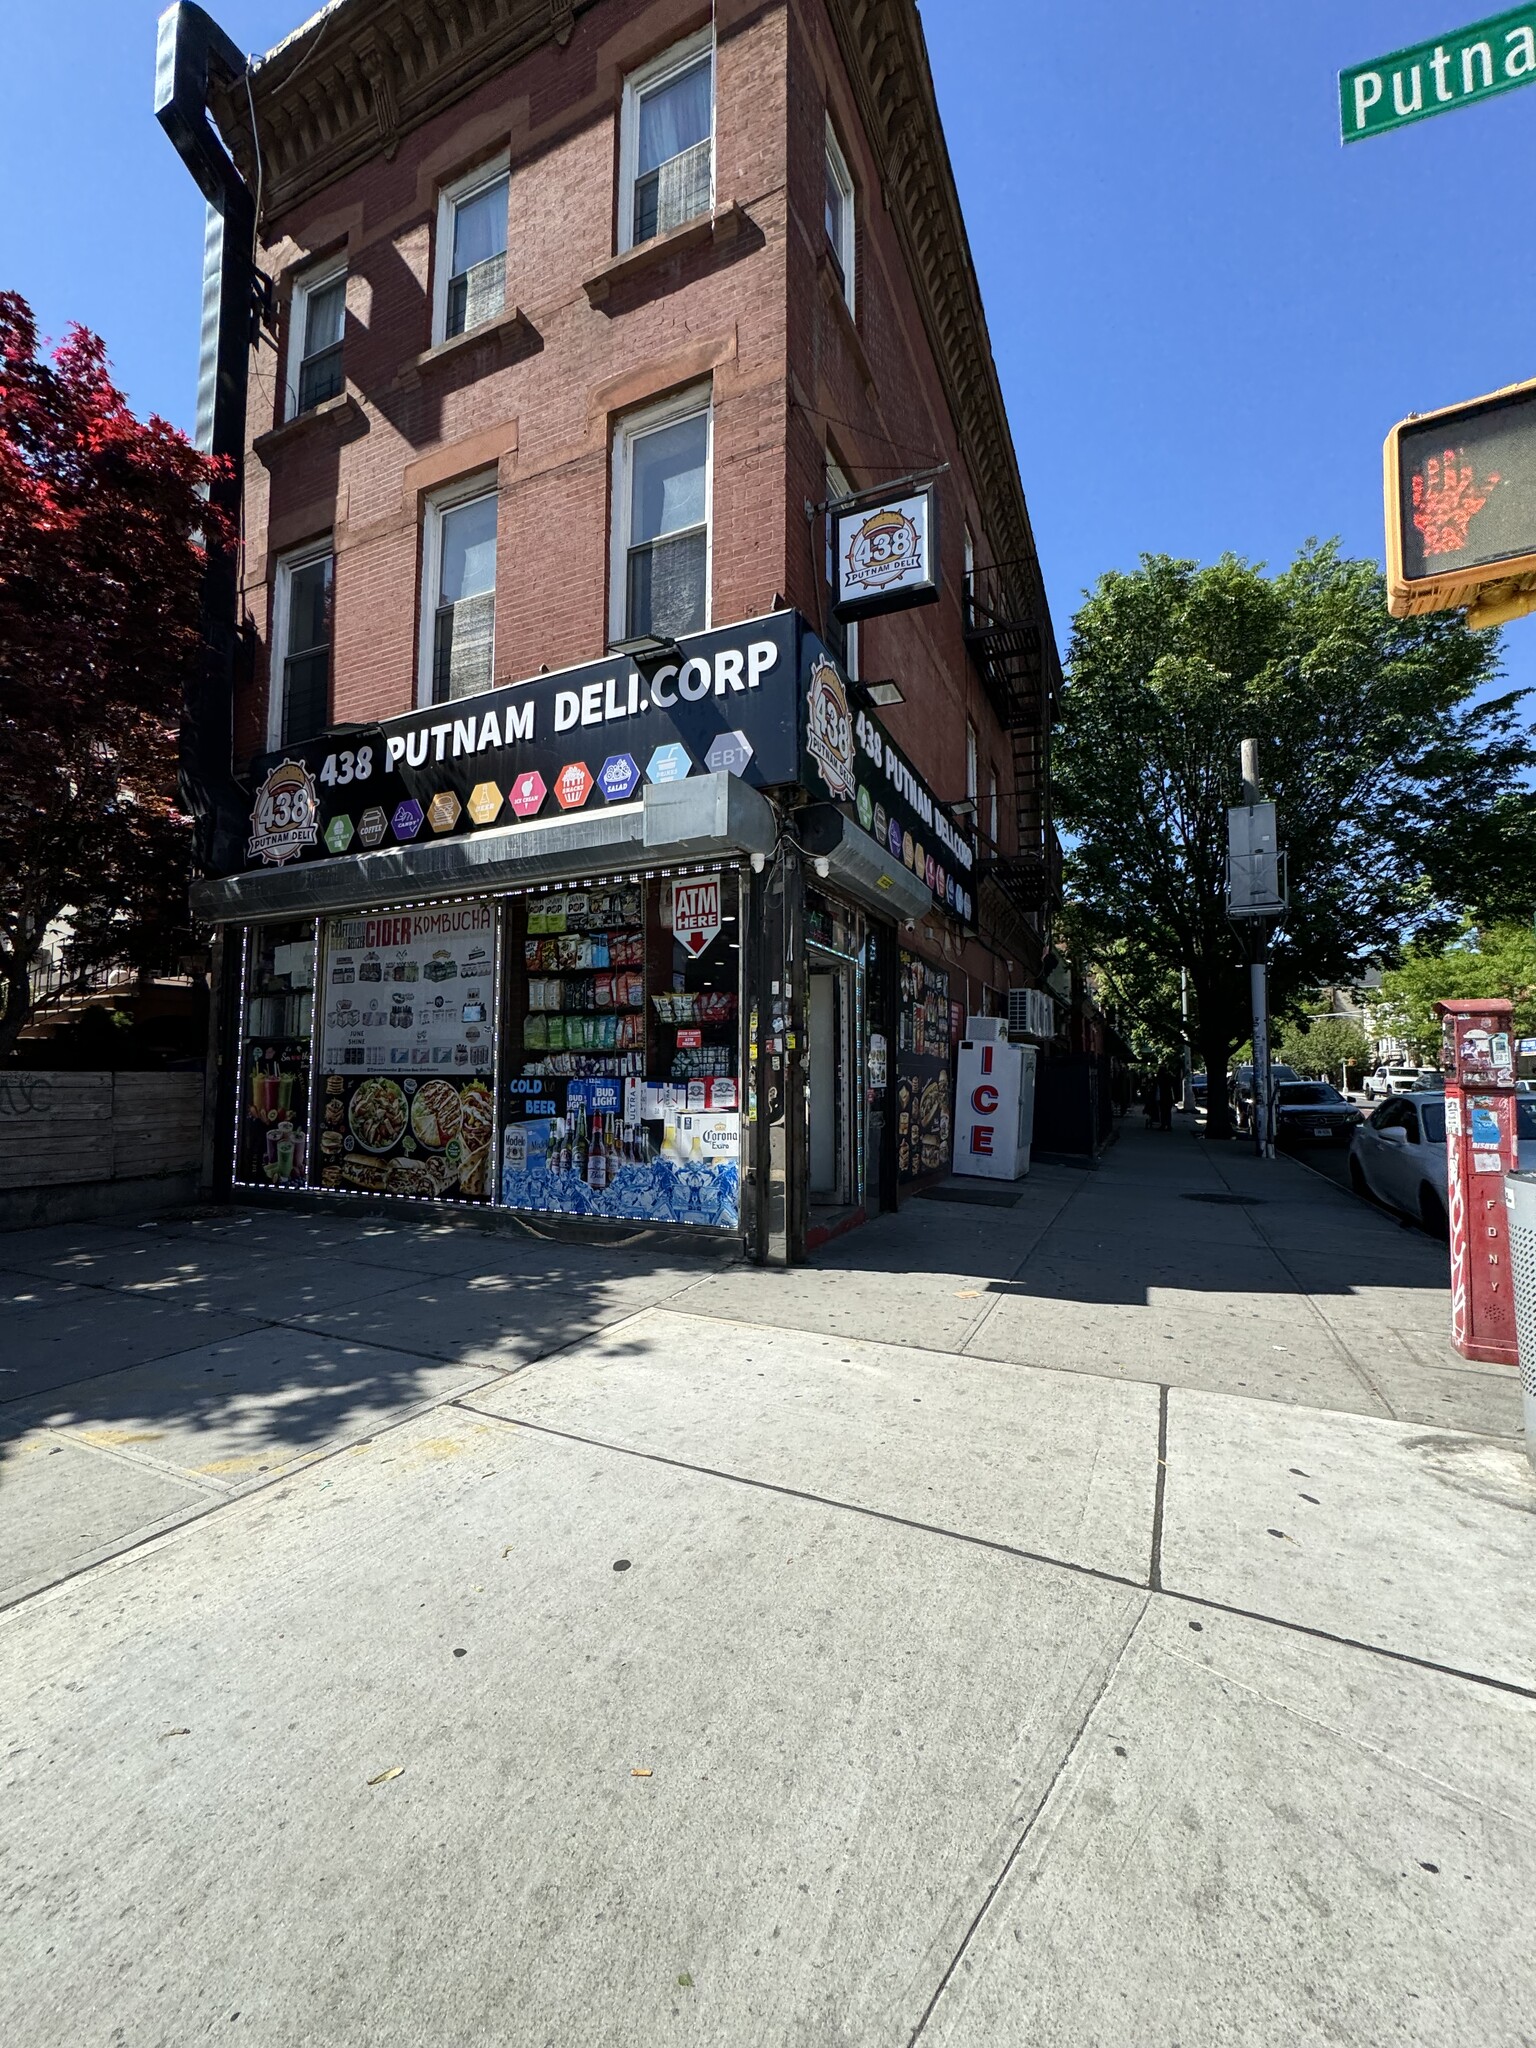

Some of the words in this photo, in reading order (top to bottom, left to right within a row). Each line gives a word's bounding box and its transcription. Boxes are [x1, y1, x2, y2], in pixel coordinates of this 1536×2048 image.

[855, 528, 910, 566] 438
[852, 565, 890, 581] PUTNAM
[894, 559, 914, 569] DELI
[815, 692, 850, 761] 438
[320, 745, 373, 786] 438
[385, 701, 535, 773] PUTNAM
[711, 746, 748, 768] EBT
[813, 737, 838, 770] PUTNAM
[839, 766, 853, 788] DELI
[856, 710, 883, 769] 438
[885, 744, 933, 828] PUTNAM
[562, 785, 584, 794] SNACKS
[607, 783, 628, 793] SALAD
[523, 795, 539, 804] CREAM
[259, 788, 309, 829] 438
[360, 824, 382, 835] COFFEE
[397, 820, 418, 829] CANDY
[254, 833, 289, 849] PUTNAM
[292, 830, 311, 841] DELI
[546, 904, 562, 914] POP
[568, 902, 585, 913] POP
[676, 886, 717, 917] ATM
[366, 917, 412, 948] CIDER
[413, 908, 491, 936] KOMBUCHA
[677, 913, 717, 929] HERE
[510, 1079, 543, 1094] COLD
[596, 1088, 614, 1097] BUD
[568, 1094, 583, 1102] BUD
[592, 1097, 617, 1106] LIGHT
[970, 1046, 999, 1157] ICE
[525, 1099, 556, 1115] BEER
[703, 1130, 738, 1144] Corona
[1487, 1200, 1499, 1292] FDNY
